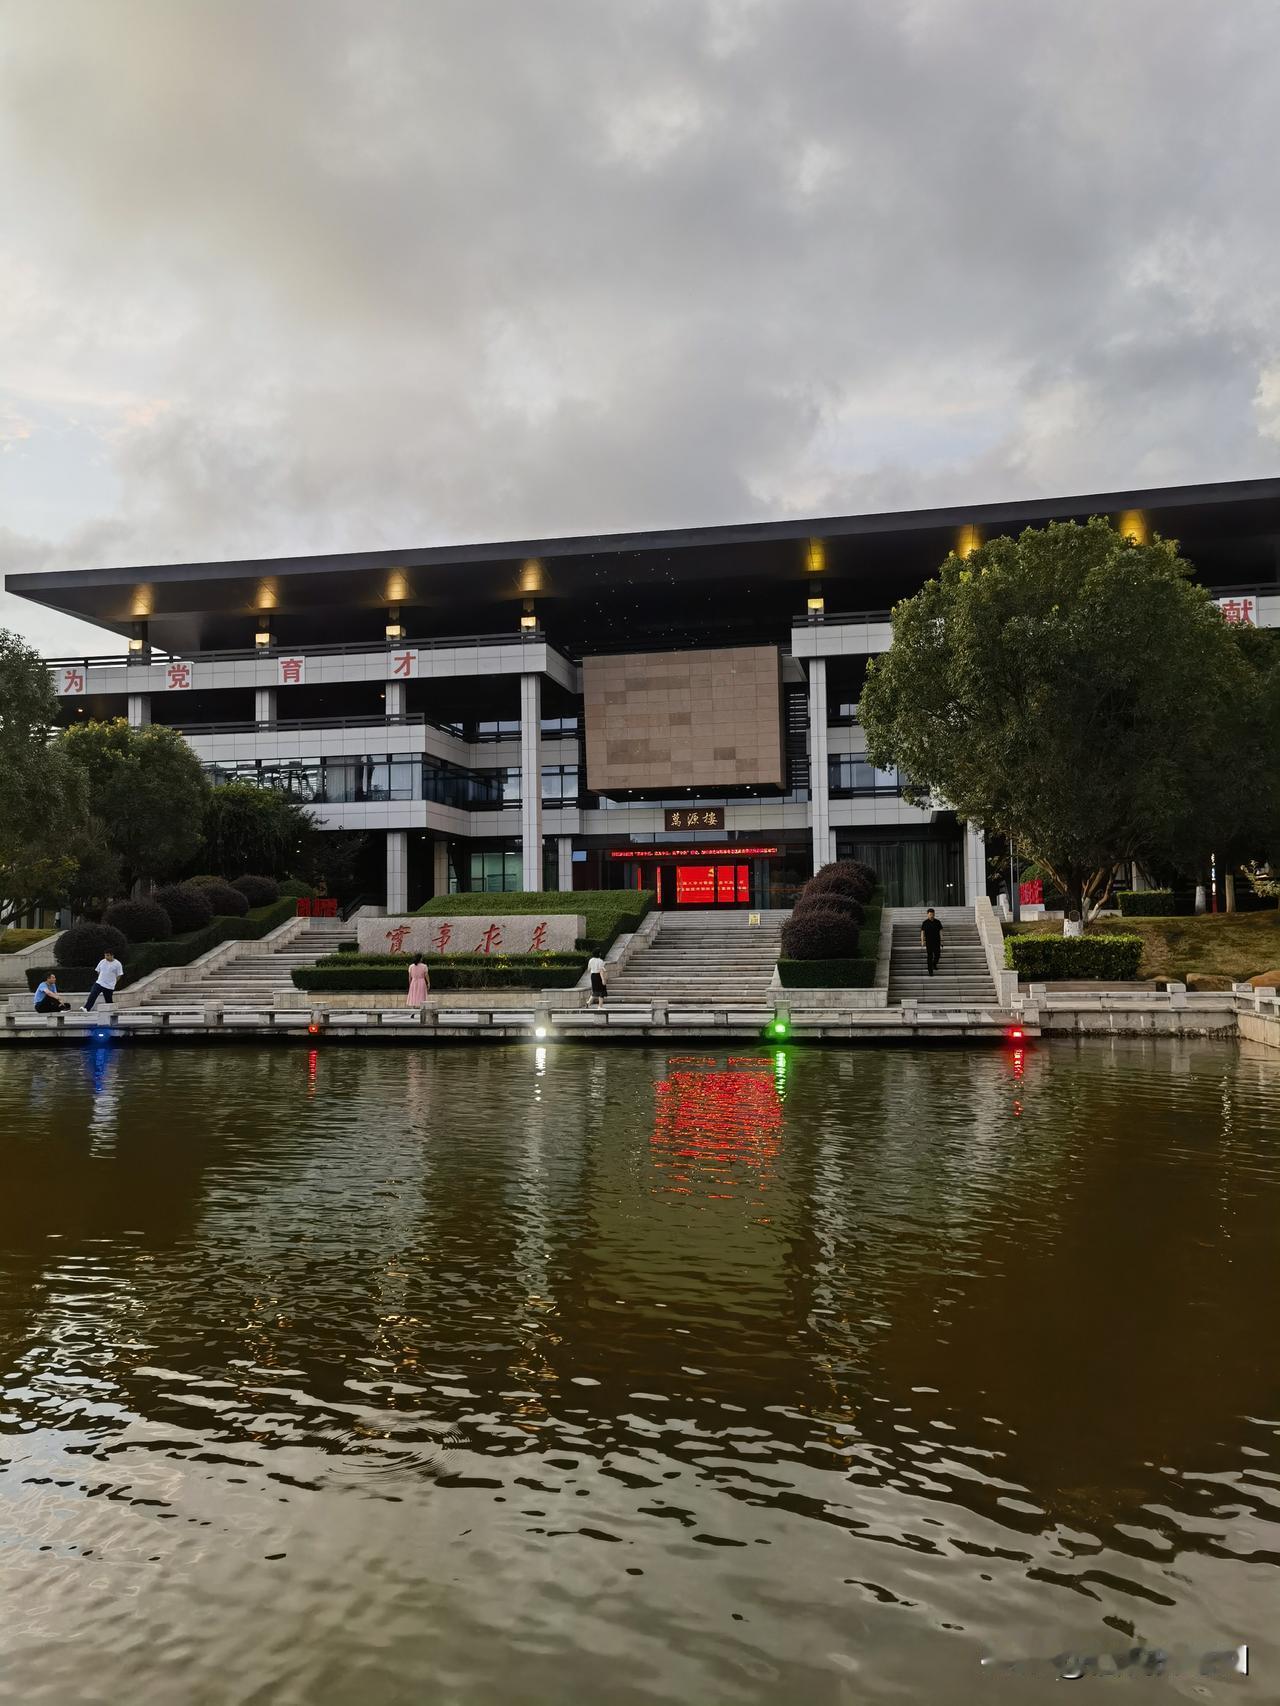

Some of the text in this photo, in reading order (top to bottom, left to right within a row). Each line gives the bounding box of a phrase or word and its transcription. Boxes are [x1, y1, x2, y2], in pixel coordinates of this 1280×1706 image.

[1222, 598, 1254, 625] 献
[63, 651, 417, 694] 为党育才
